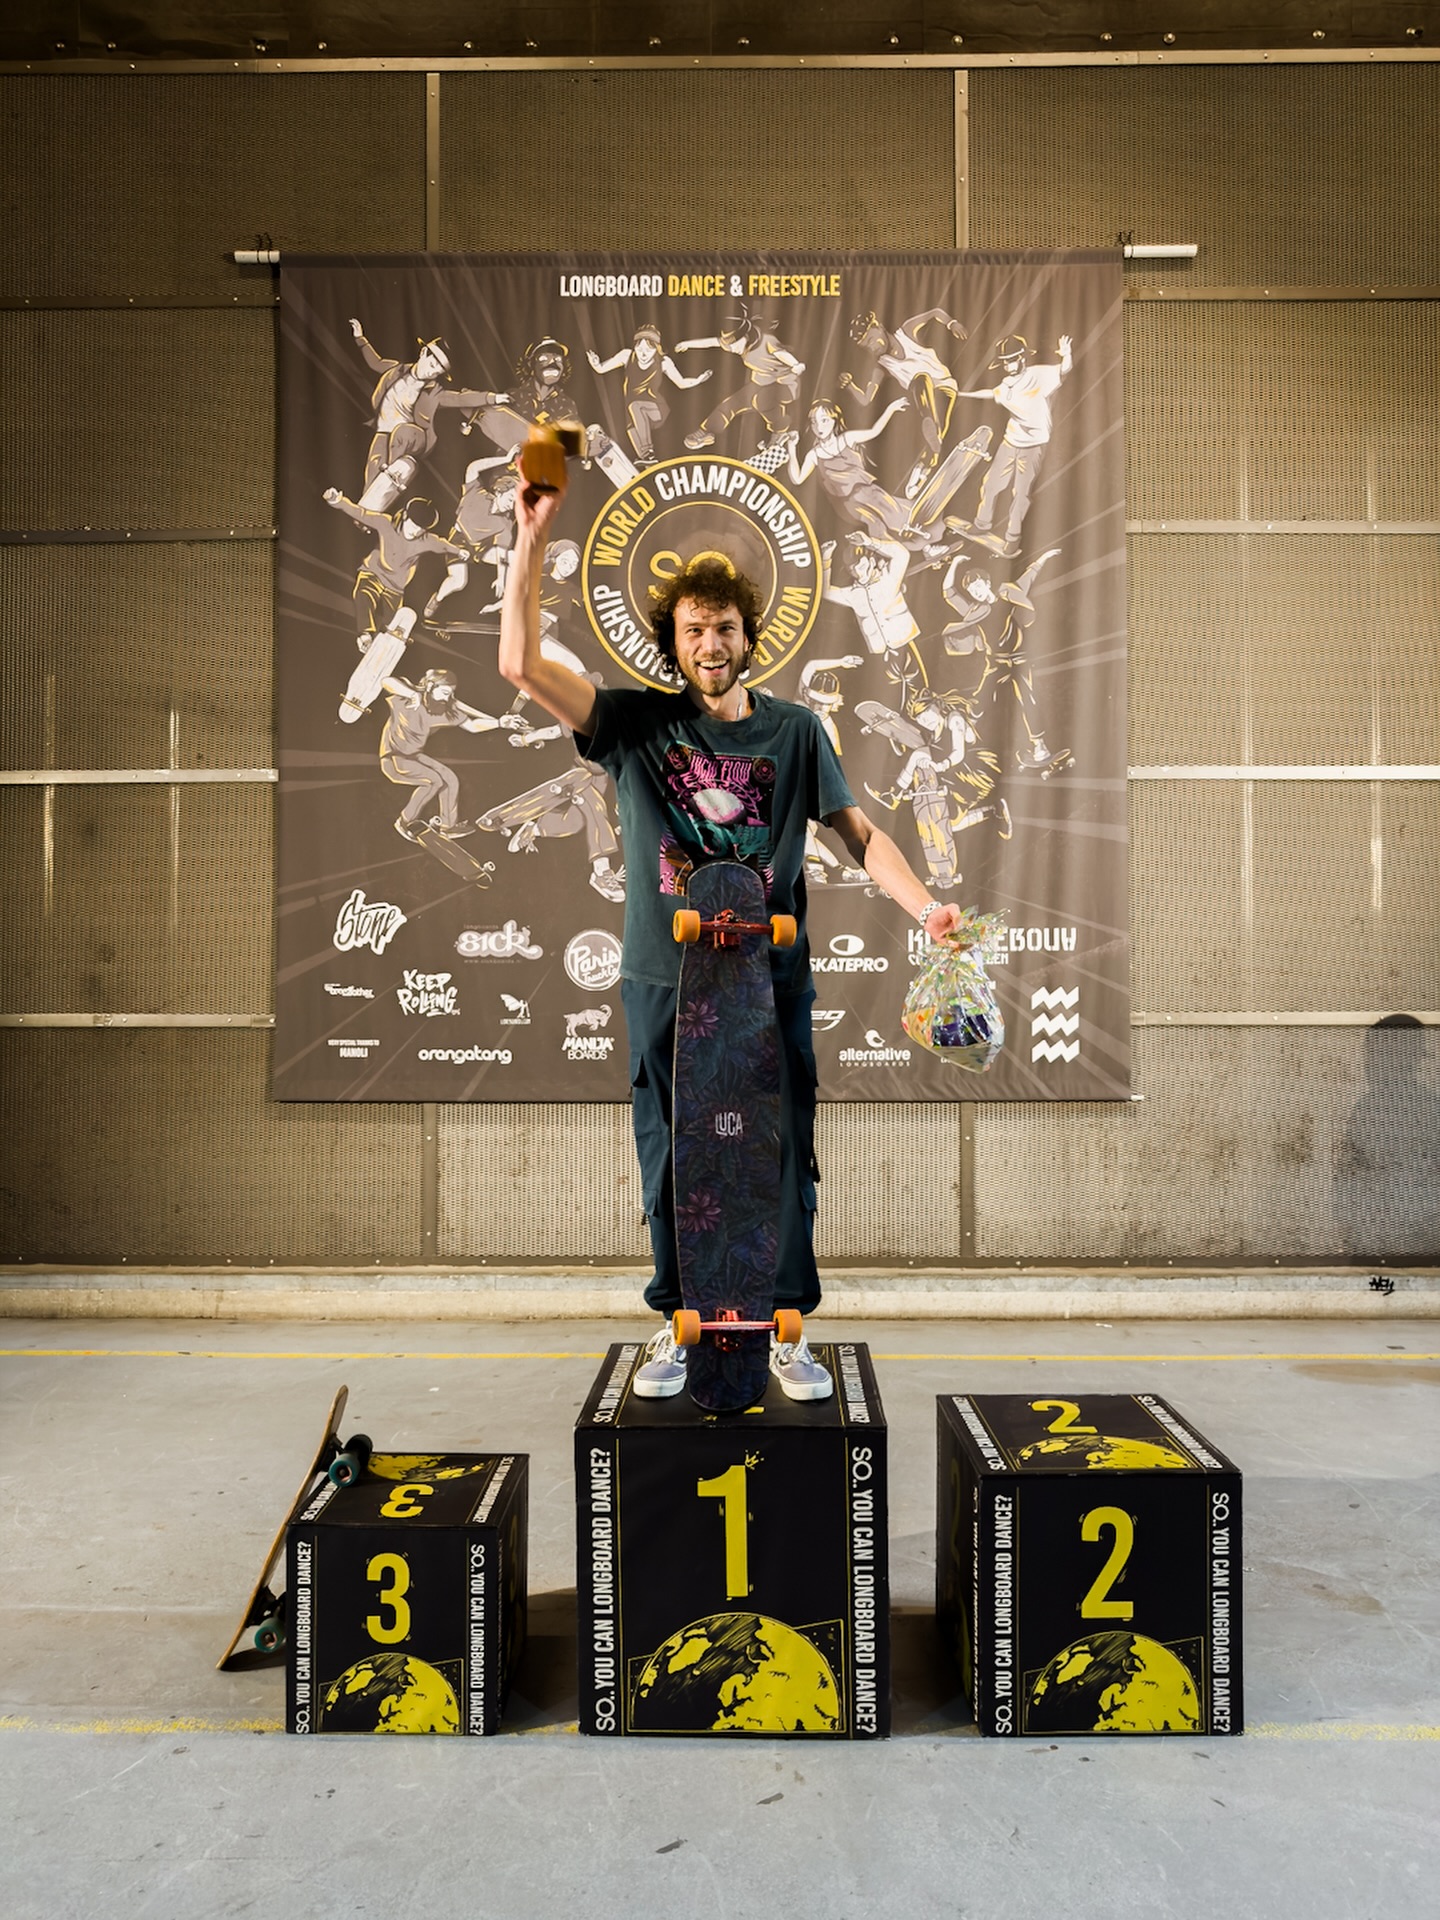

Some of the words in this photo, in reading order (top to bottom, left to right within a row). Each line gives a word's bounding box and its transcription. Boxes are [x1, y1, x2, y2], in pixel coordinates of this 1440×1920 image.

[559, 275, 663, 297] LONGBOARD
[667, 275, 725, 297] DANCE
[729, 275, 744, 297] &
[748, 275, 841, 297] FREESTYLE
[592, 486, 656, 567] WORLD
[654, 465, 812, 568] CHAMPIONSHIP
[569, 945, 621, 978] Paris
[402, 968, 453, 992] KEEP
[418, 1045, 513, 1065] orangatang
[567, 1050, 608, 1061] BOARDS
[838, 1048, 912, 1062] alternative
[715, 1111, 744, 1137] LUCA
[1031, 1400, 1098, 1434] 2
[590, 1447, 612, 1513] DANCE?
[379, 1483, 434, 1519] 3
[852, 1488, 874, 1522] YOU
[696, 1464, 749, 1598] 1
[994, 1494, 1013, 1549] DANCE?
[853, 1526, 874, 1560] CAN
[1212, 1527, 1230, 1555] YOU
[297, 1541, 312, 1585] DANCE?
[592, 1517, 614, 1614] LONGBOARD
[1080, 1506, 1134, 1619] 2
[1212, 1559, 1230, 1587] CAN
[365, 1552, 411, 1645] 3
[470, 1570, 485, 1595] YOU
[994, 1552, 1013, 1635] LONGBOARD
[296, 1587, 312, 1654] LONGBOARD
[470, 1597, 485, 1620] CAN
[854, 1565, 876, 1664] LONGBOARD
[593, 1619, 615, 1653] CAN
[1212, 1591, 1230, 1674] LONGBOARD
[296, 1657, 311, 1680] CAN
[470, 1622, 485, 1689] LONGBOARD
[994, 1638, 1013, 1667] CAN
[594, 1657, 615, 1690] YOU
[994, 1670, 1013, 1699] YOU
[296, 1682, 311, 1704] YOU
[855, 1668, 877, 1733] DANCE?
[1212, 1678, 1231, 1733] DANCE?
[469, 1691, 485, 1736] DANCE?
